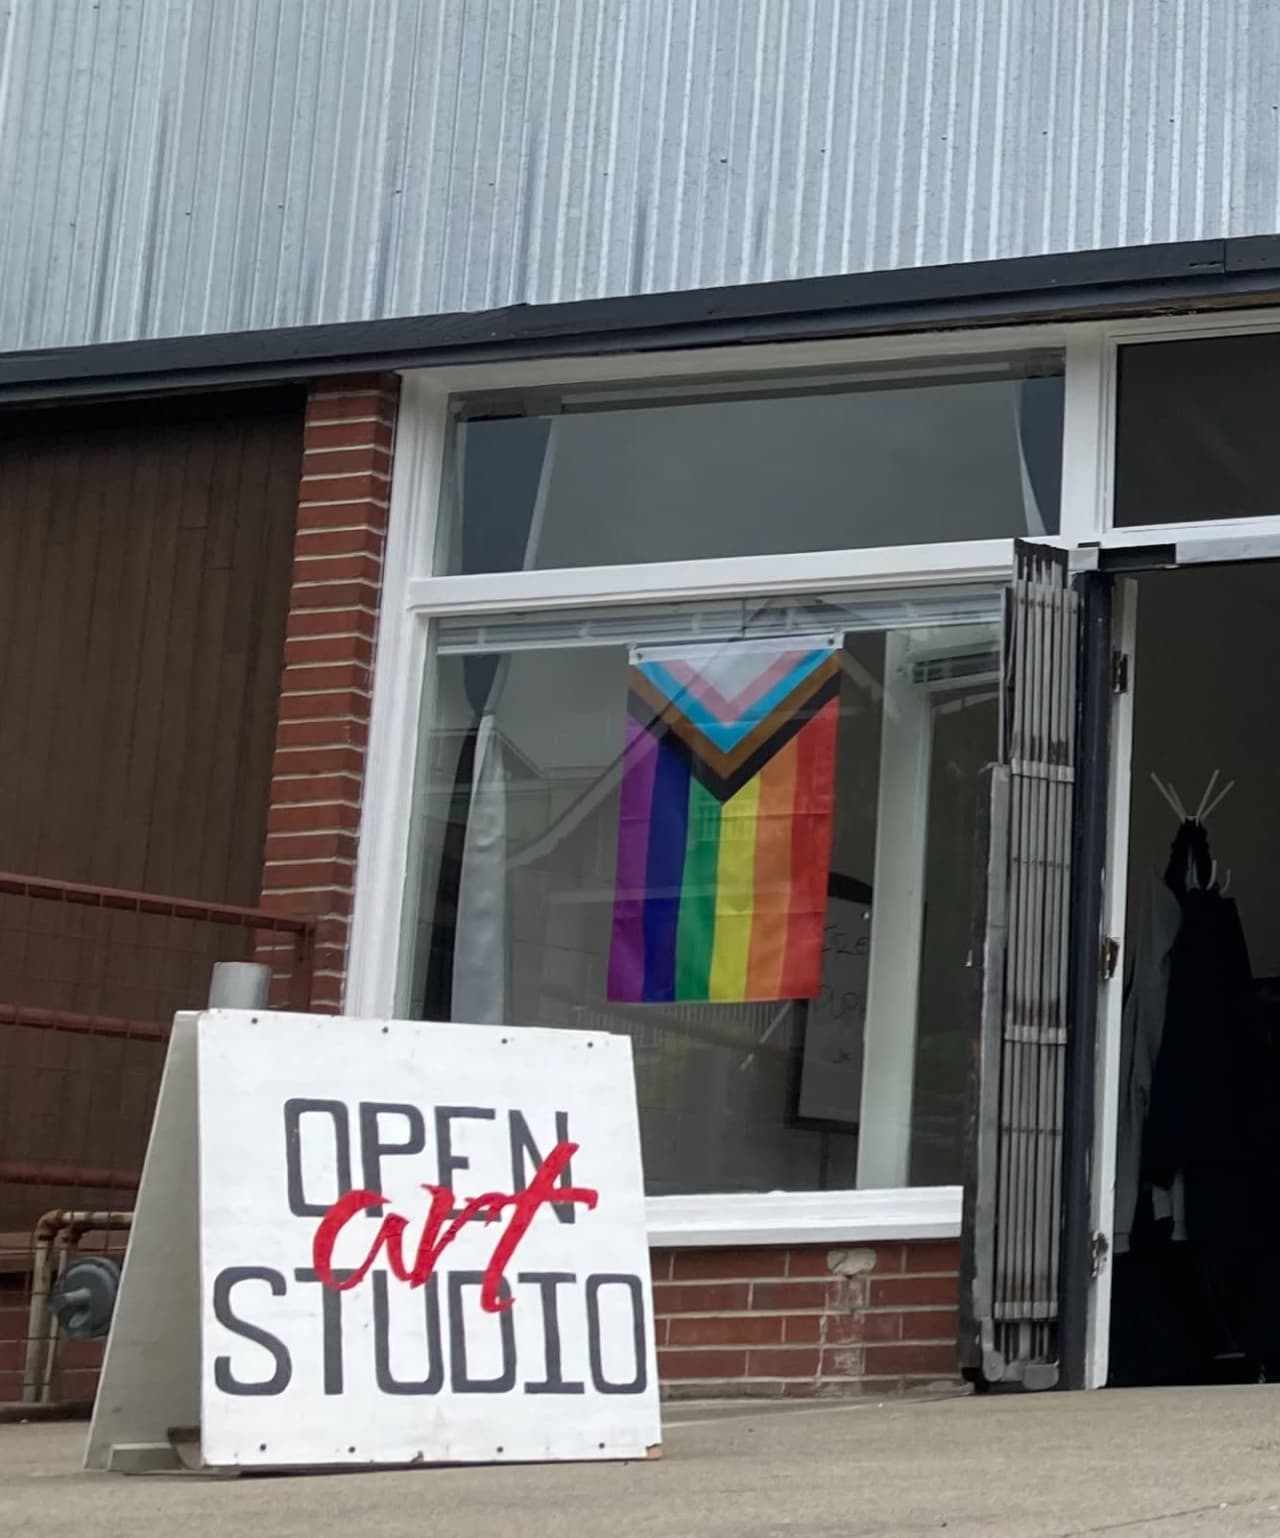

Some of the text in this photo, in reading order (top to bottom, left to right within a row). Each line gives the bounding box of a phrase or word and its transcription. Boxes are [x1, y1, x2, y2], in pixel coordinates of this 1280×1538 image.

[284, 1098, 576, 1225] OPEN
[312, 1141, 599, 1313] art
[213, 1267, 647, 1397] STUDIO
